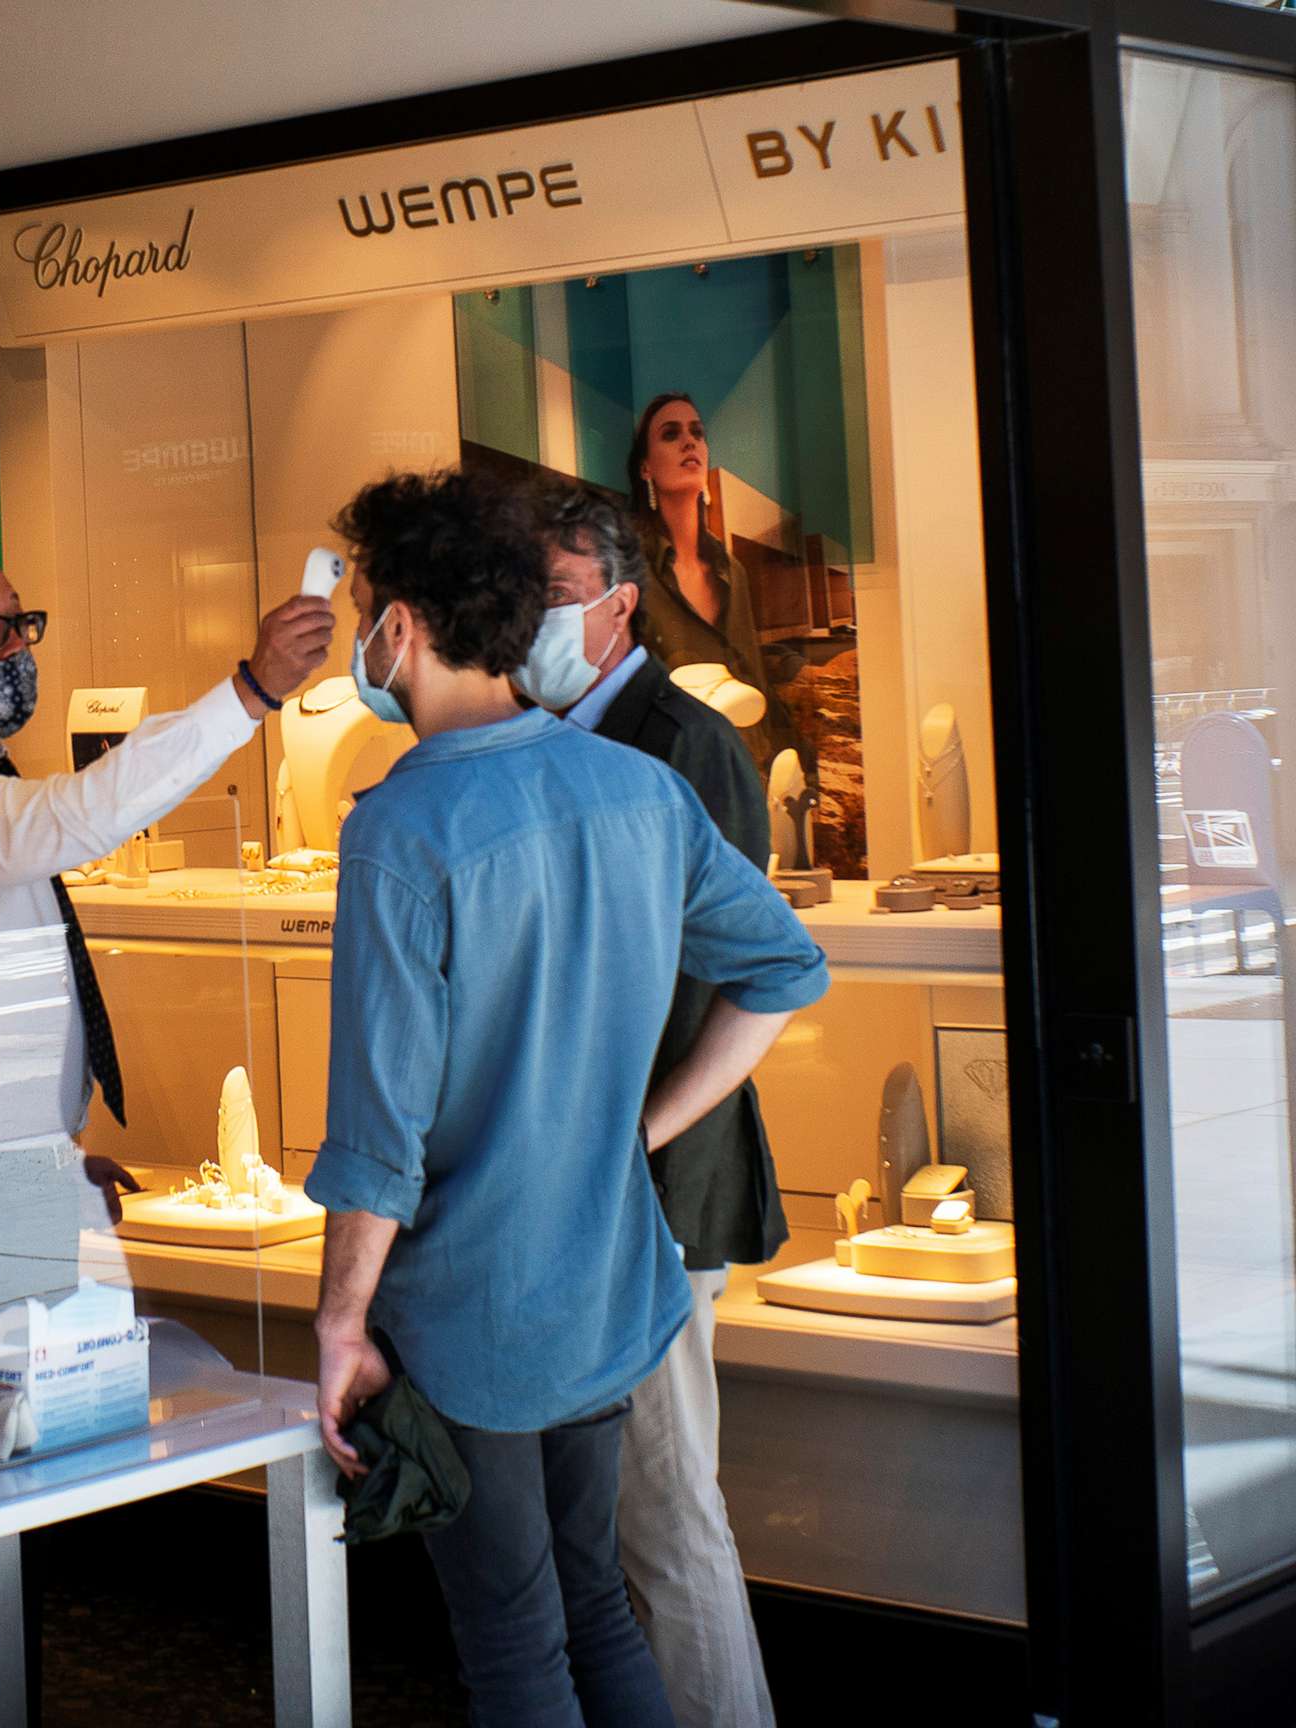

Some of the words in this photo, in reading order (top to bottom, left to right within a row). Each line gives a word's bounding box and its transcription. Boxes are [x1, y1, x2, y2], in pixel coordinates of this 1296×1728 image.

[746, 120, 836, 178] BY
[871, 99, 960, 160] KI
[338, 161, 583, 239] WEMPE
[13, 207, 196, 298] Chopard
